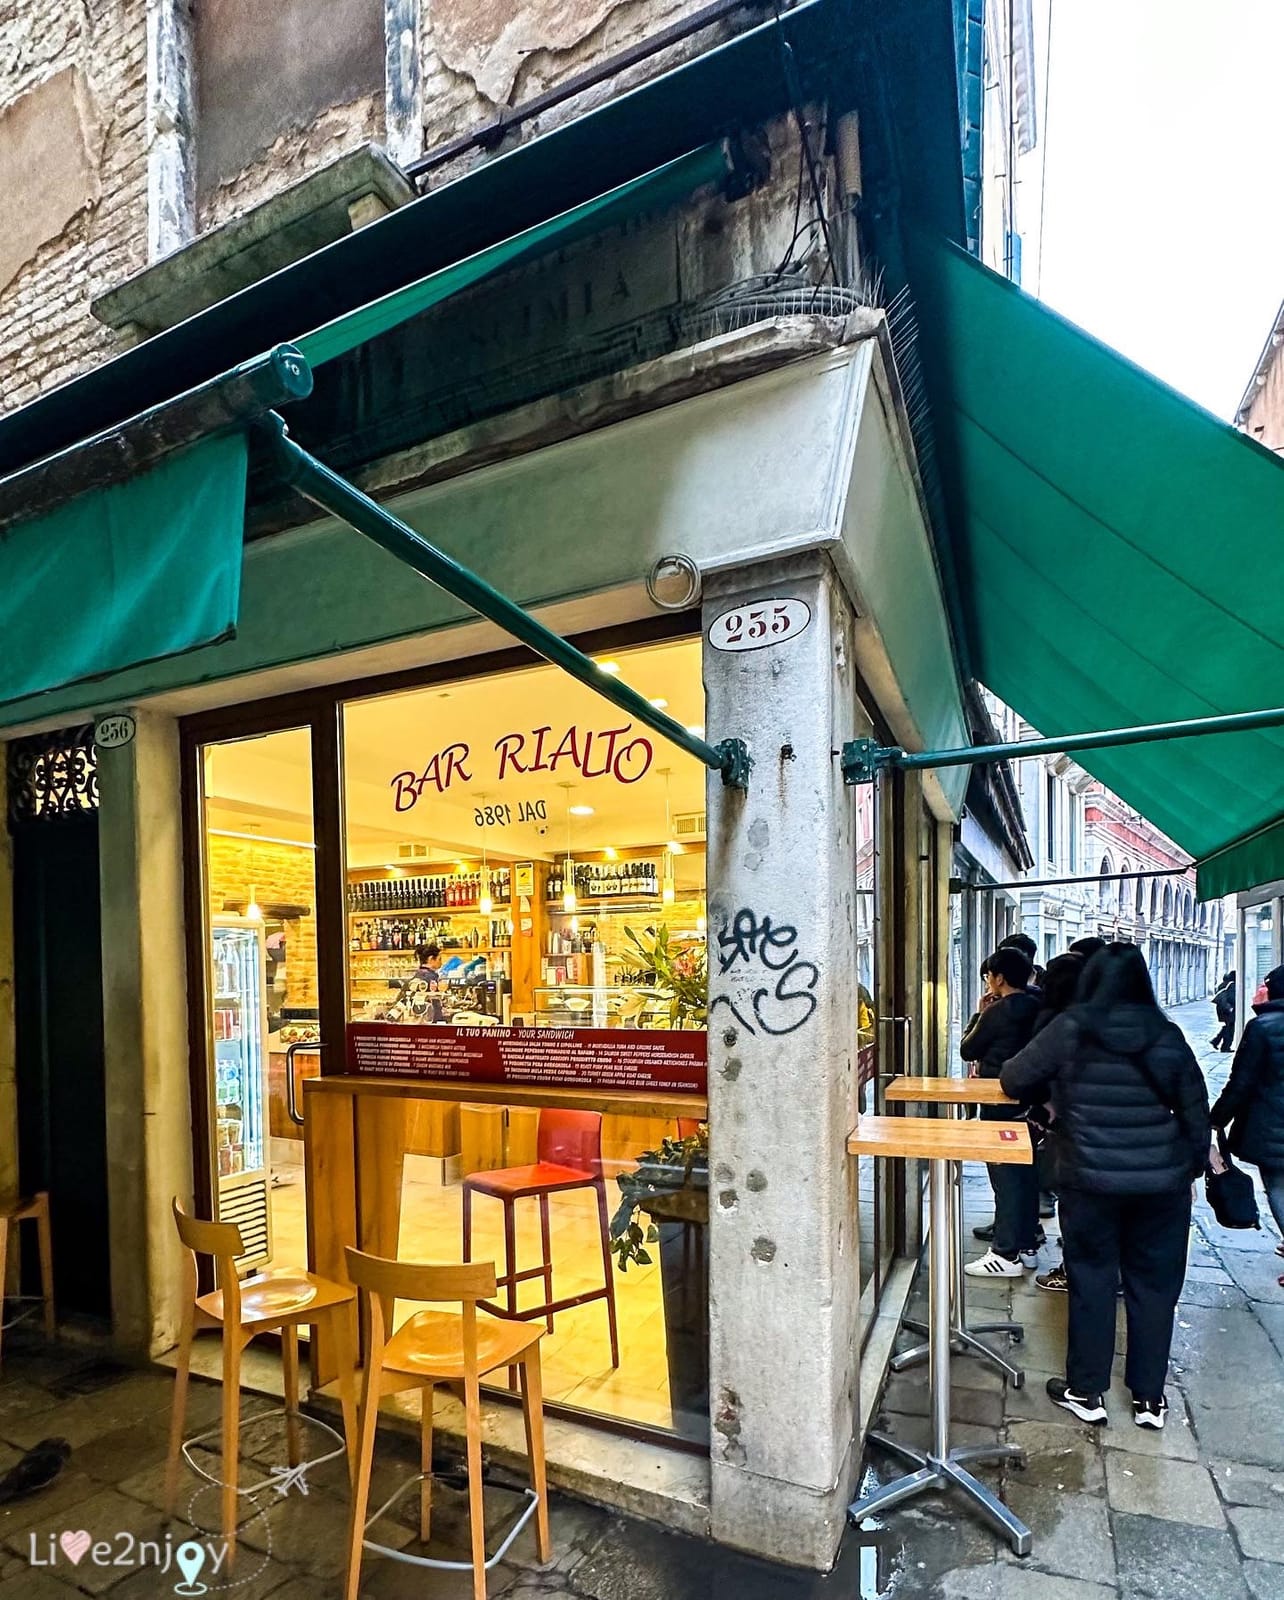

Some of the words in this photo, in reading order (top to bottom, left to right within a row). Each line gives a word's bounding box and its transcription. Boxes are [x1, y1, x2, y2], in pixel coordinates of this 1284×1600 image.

[725, 605, 791, 643] 235
[390, 742, 472, 813] BAR
[494, 723, 653, 784] RIALTO
[456, 1028, 465, 1036] IL
[465, 1028, 480, 1037] TUO
[481, 1028, 511, 1038] PANINO
[518, 1029, 536, 1039] YOUR
[537, 1030, 575, 1040] SANDWICH
